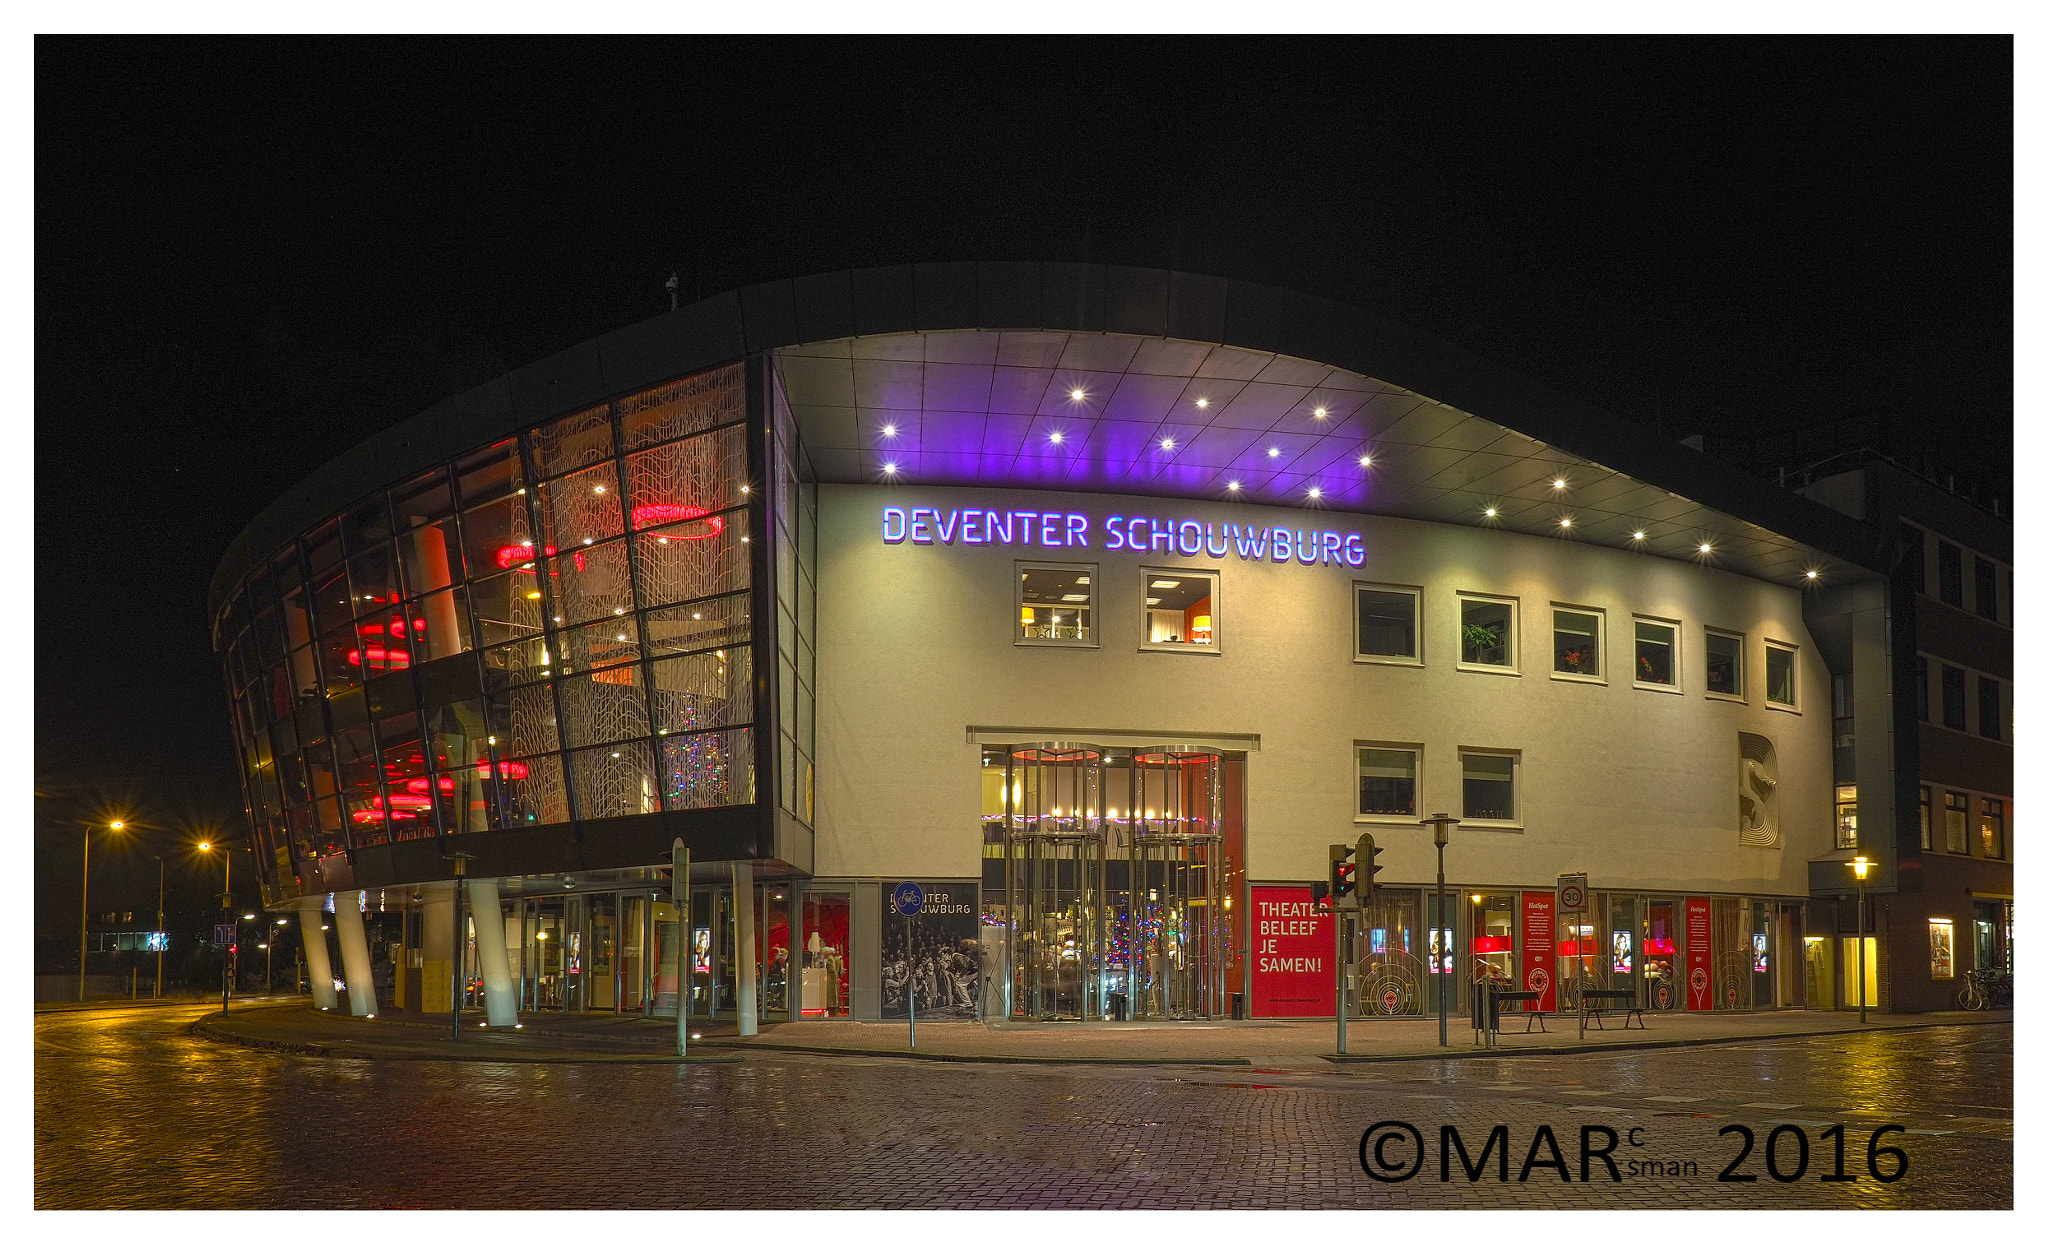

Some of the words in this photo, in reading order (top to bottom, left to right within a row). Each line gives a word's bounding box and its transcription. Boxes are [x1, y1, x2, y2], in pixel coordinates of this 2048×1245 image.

[883, 507, 1089, 547] DEVENTER
[1105, 515, 1366, 566] SCHOUWBURG
[1565, 892, 1579, 902] 30
[890, 904, 971, 914] SUWBURG
[1259, 902, 1329, 917] THEATER
[1260, 920, 1318, 935] BELEEF
[1259, 939, 1277, 954] JE
[1259, 957, 1322, 973] SAMEN!
